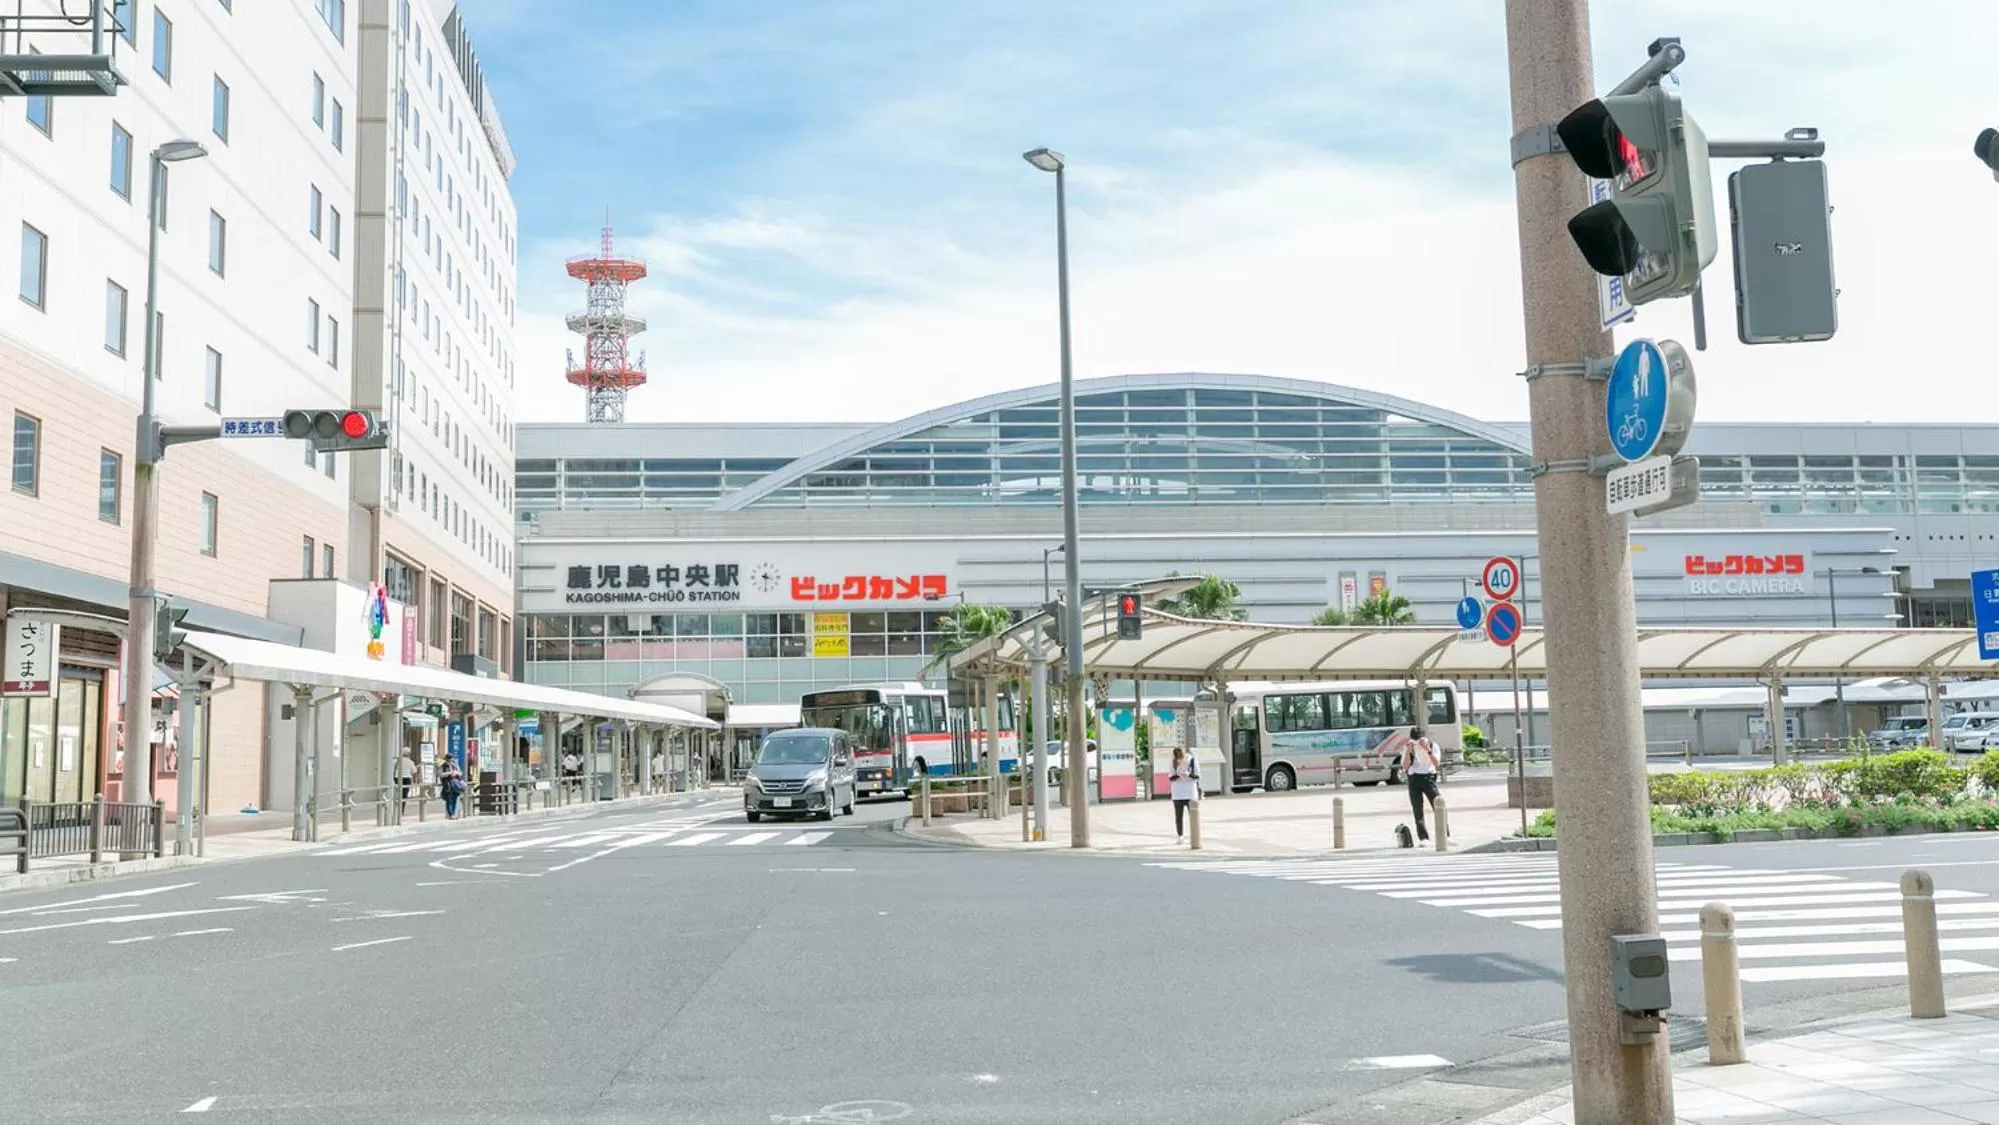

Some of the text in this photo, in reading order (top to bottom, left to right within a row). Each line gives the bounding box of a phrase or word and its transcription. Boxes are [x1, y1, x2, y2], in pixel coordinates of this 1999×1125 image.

[1685, 554, 1804, 575] ビックカメラ
[567, 564, 739, 589] 鹿児島中央駅
[1491, 568, 1511, 588] 40
[1690, 578, 1804, 594] BIC CAMERA
[689, 591, 740, 601] STATION
[791, 575, 947, 600] ビックカメラ
[21, 622, 38, 677] さつま
